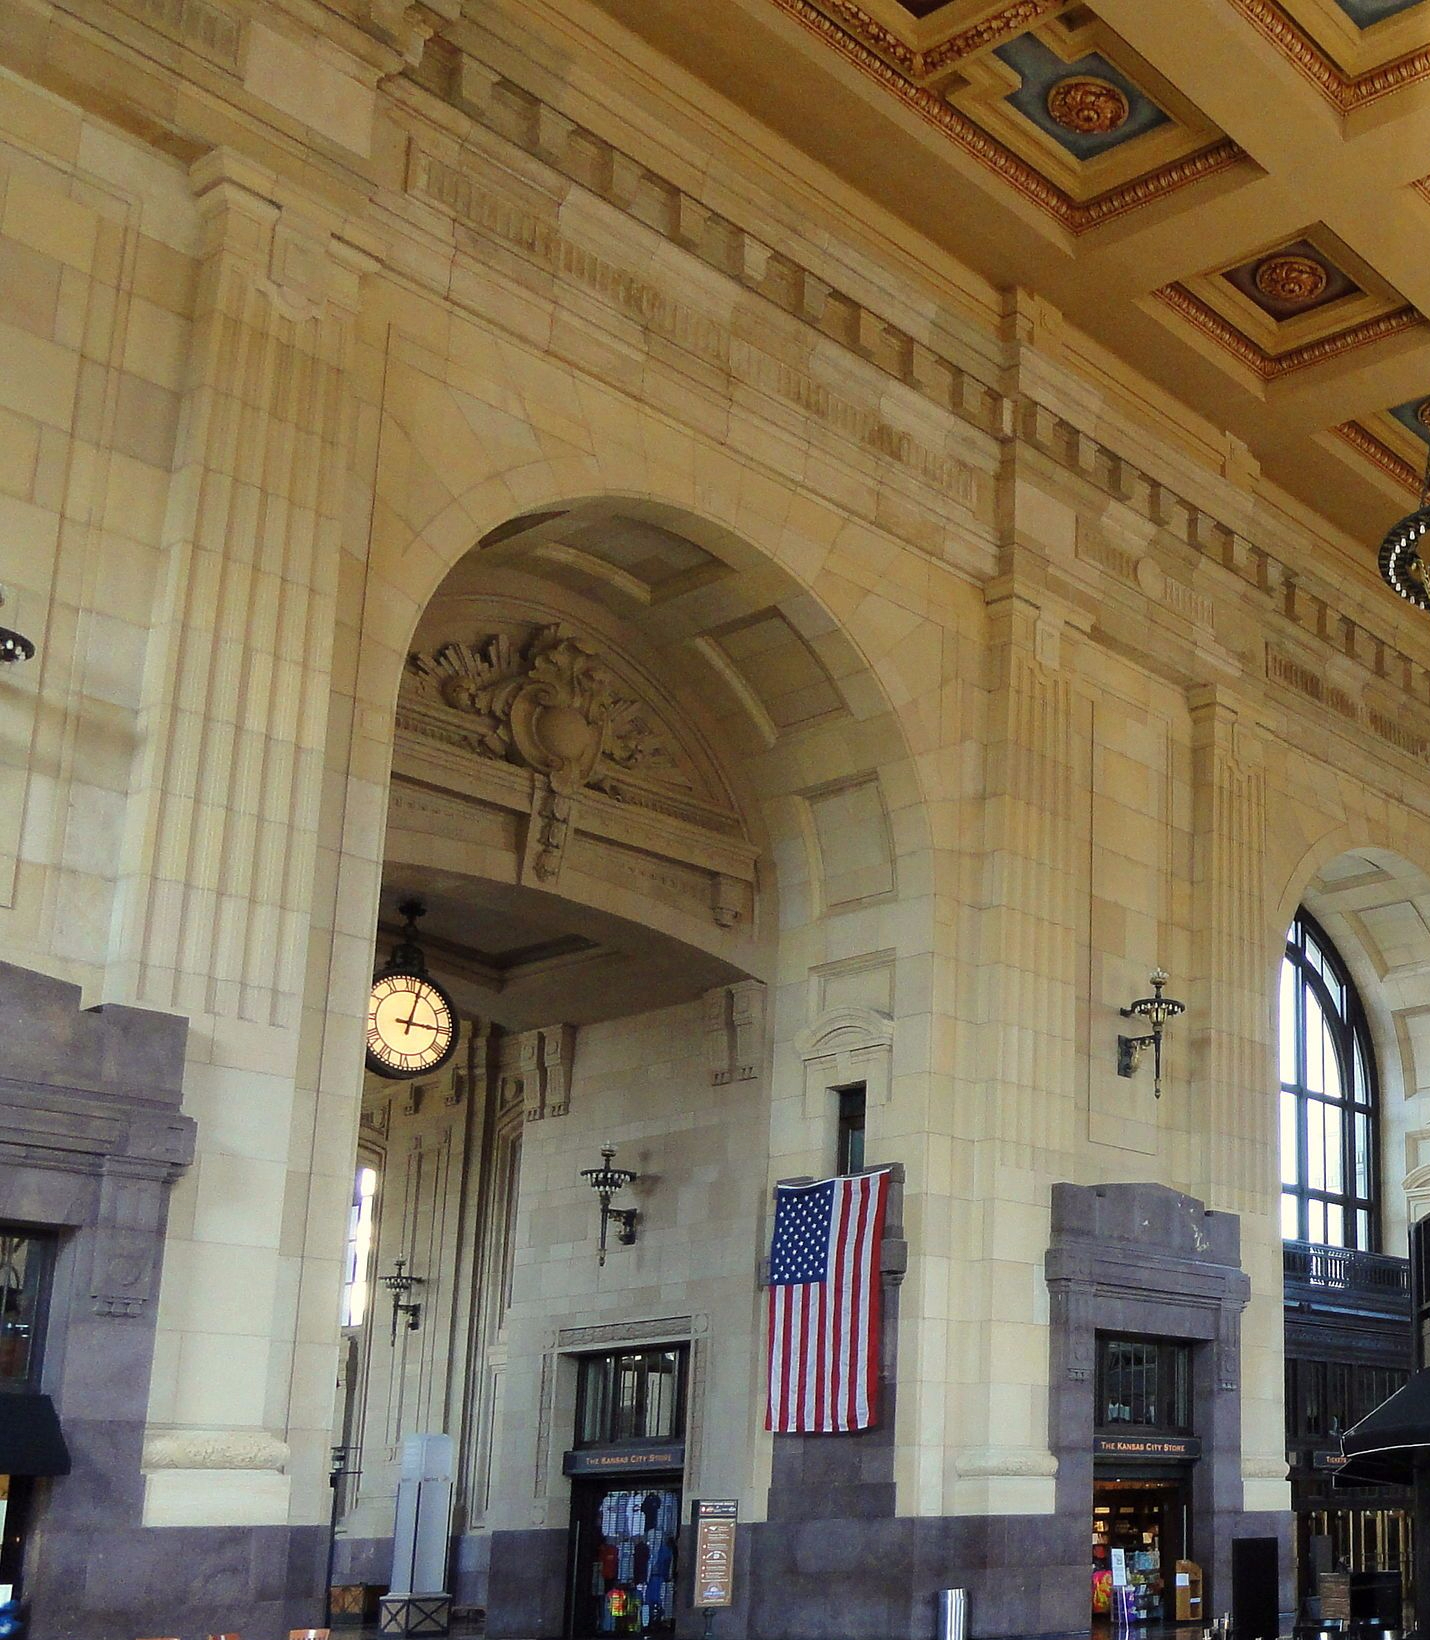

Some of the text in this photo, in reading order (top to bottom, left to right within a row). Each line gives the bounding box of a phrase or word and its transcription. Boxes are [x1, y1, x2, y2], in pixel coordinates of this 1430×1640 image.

[1101, 1441, 1185, 1452] THE KANSAS CITY STORE
[586, 1457, 600, 1465] THE
[600, 1455, 629, 1465] KANSAS
[630, 1454, 648, 1463] CITY
